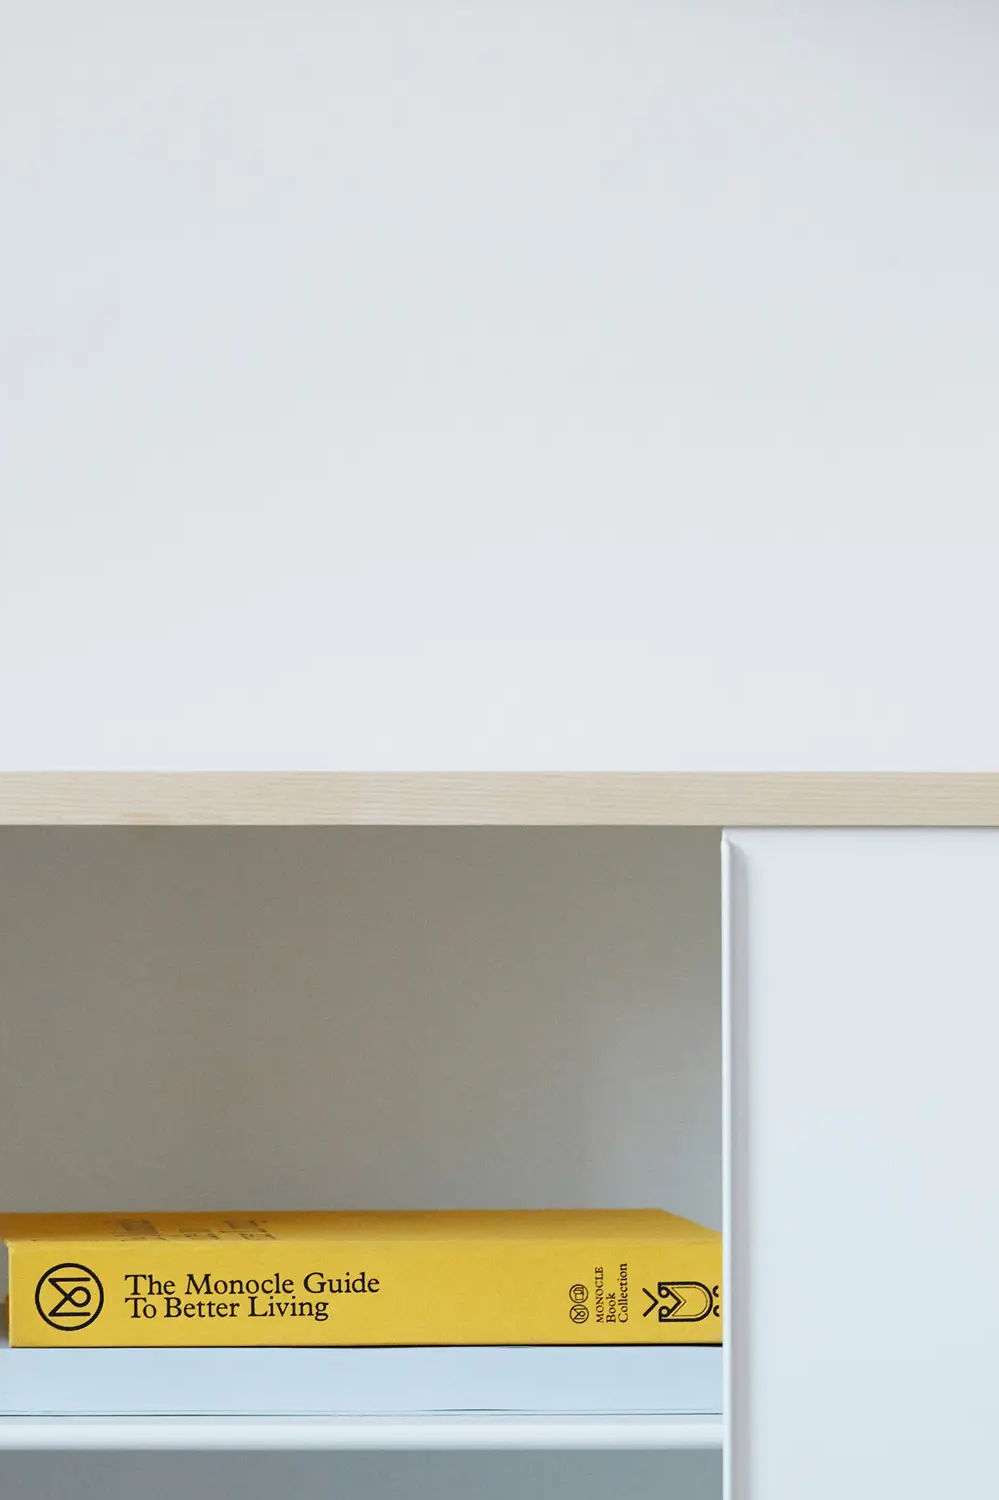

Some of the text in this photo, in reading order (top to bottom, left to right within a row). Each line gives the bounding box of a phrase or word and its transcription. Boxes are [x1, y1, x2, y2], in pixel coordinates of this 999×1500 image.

[125, 1272, 380, 1295] The Monocle Guide
[595, 1266, 604, 1323] MONOCLE
[617, 1263, 629, 1323] Collection
[125, 1297, 329, 1321] To Better Living
[606, 1292, 617, 1323] Book
